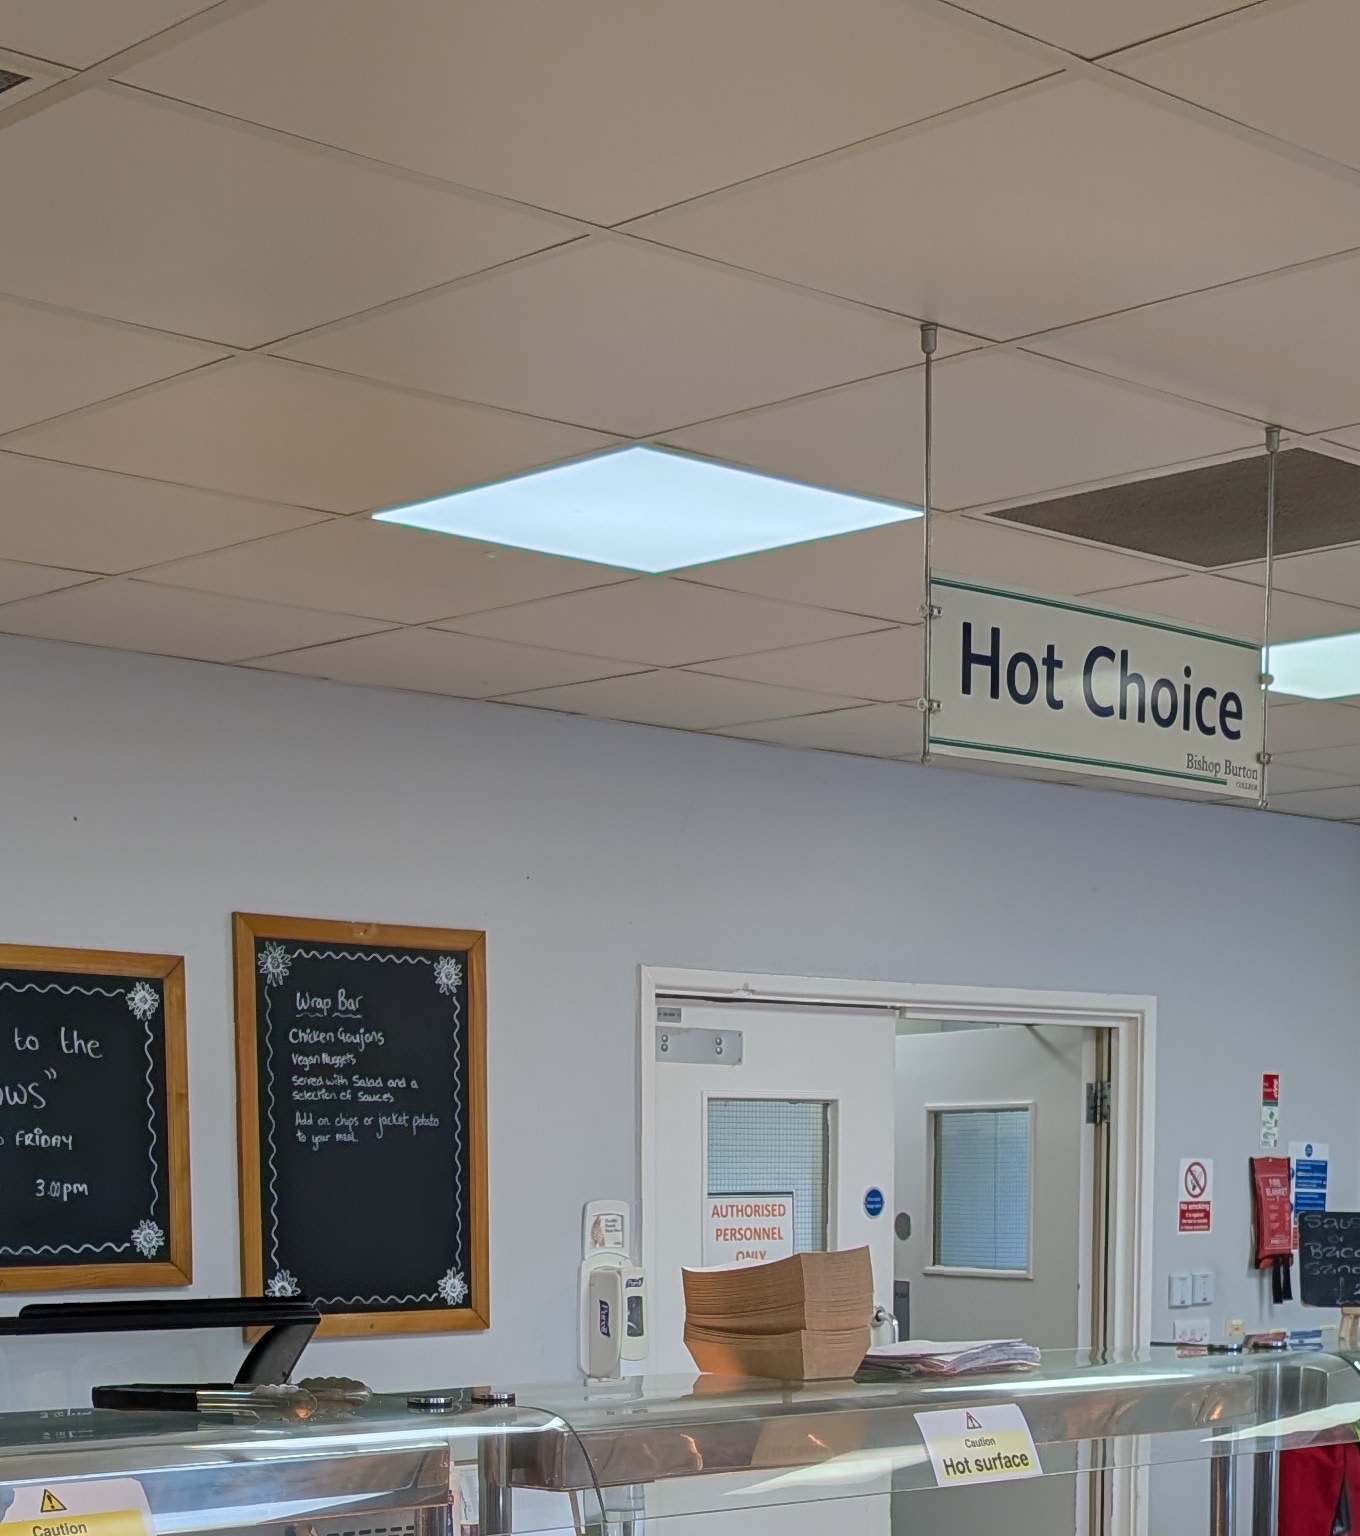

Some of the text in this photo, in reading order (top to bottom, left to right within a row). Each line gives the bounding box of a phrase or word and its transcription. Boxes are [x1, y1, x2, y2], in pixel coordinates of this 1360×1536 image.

[961, 621, 1243, 741] Hot Choice
[1185, 753, 1258, 781] Bishop Burton
[295, 988, 364, 1016] Wrap Bar
[14, 1027, 39, 1051] to
[60, 1026, 102, 1058] the
[289, 1027, 385, 1052] Chicken Goujons
[291, 1053, 320, 1071] Vegan
[326, 1073, 348, 1086] with
[387, 1077, 407, 1088] and
[340, 1089, 352, 1100] of
[295, 1111, 313, 1126] Add
[335, 1113, 359, 1132] chips
[363, 1117, 374, 1126] or
[376, 1112, 409, 1139] jacket
[412, 1114, 440, 1135] potato
[296, 1130, 306, 1142] to
[711, 1203, 786, 1218] AUTHORISED
[715, 1227, 784, 1241] PERSONNEL
[964, 1437, 996, 1449] Caution
[942, 1451, 1030, 1477] Hot surface
